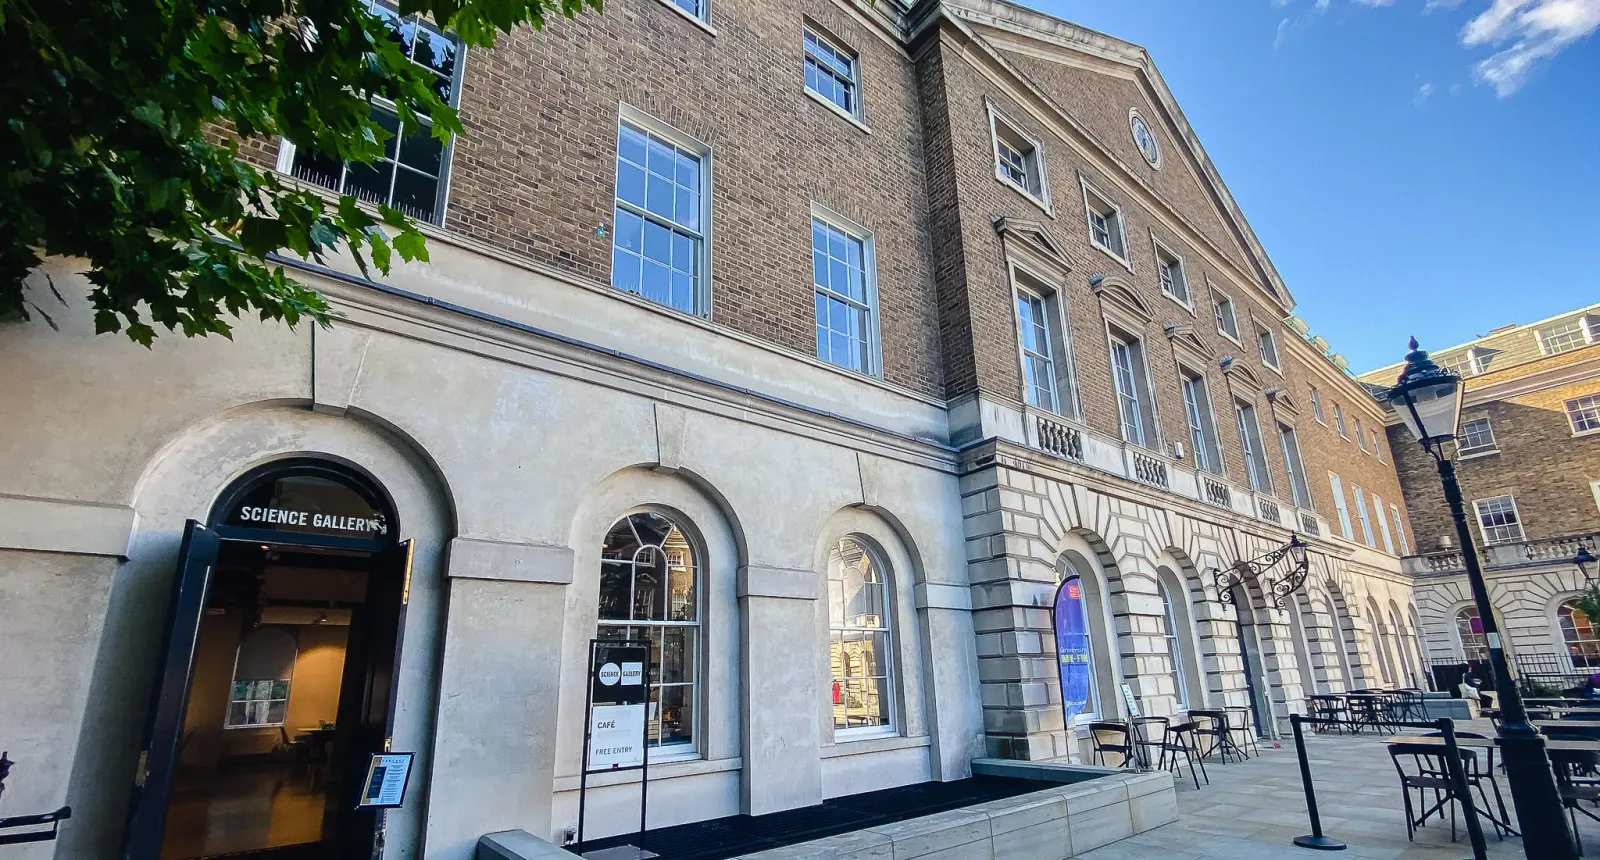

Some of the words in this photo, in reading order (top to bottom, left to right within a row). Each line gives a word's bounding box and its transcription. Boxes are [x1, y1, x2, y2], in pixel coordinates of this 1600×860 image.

[240, 506, 309, 526] SCIENCE
[312, 513, 372, 532] GALLERY
[597, 719, 615, 729] CAFÉ
[595, 748, 611, 756] FREE
[612, 746, 632, 755] ENTRY
